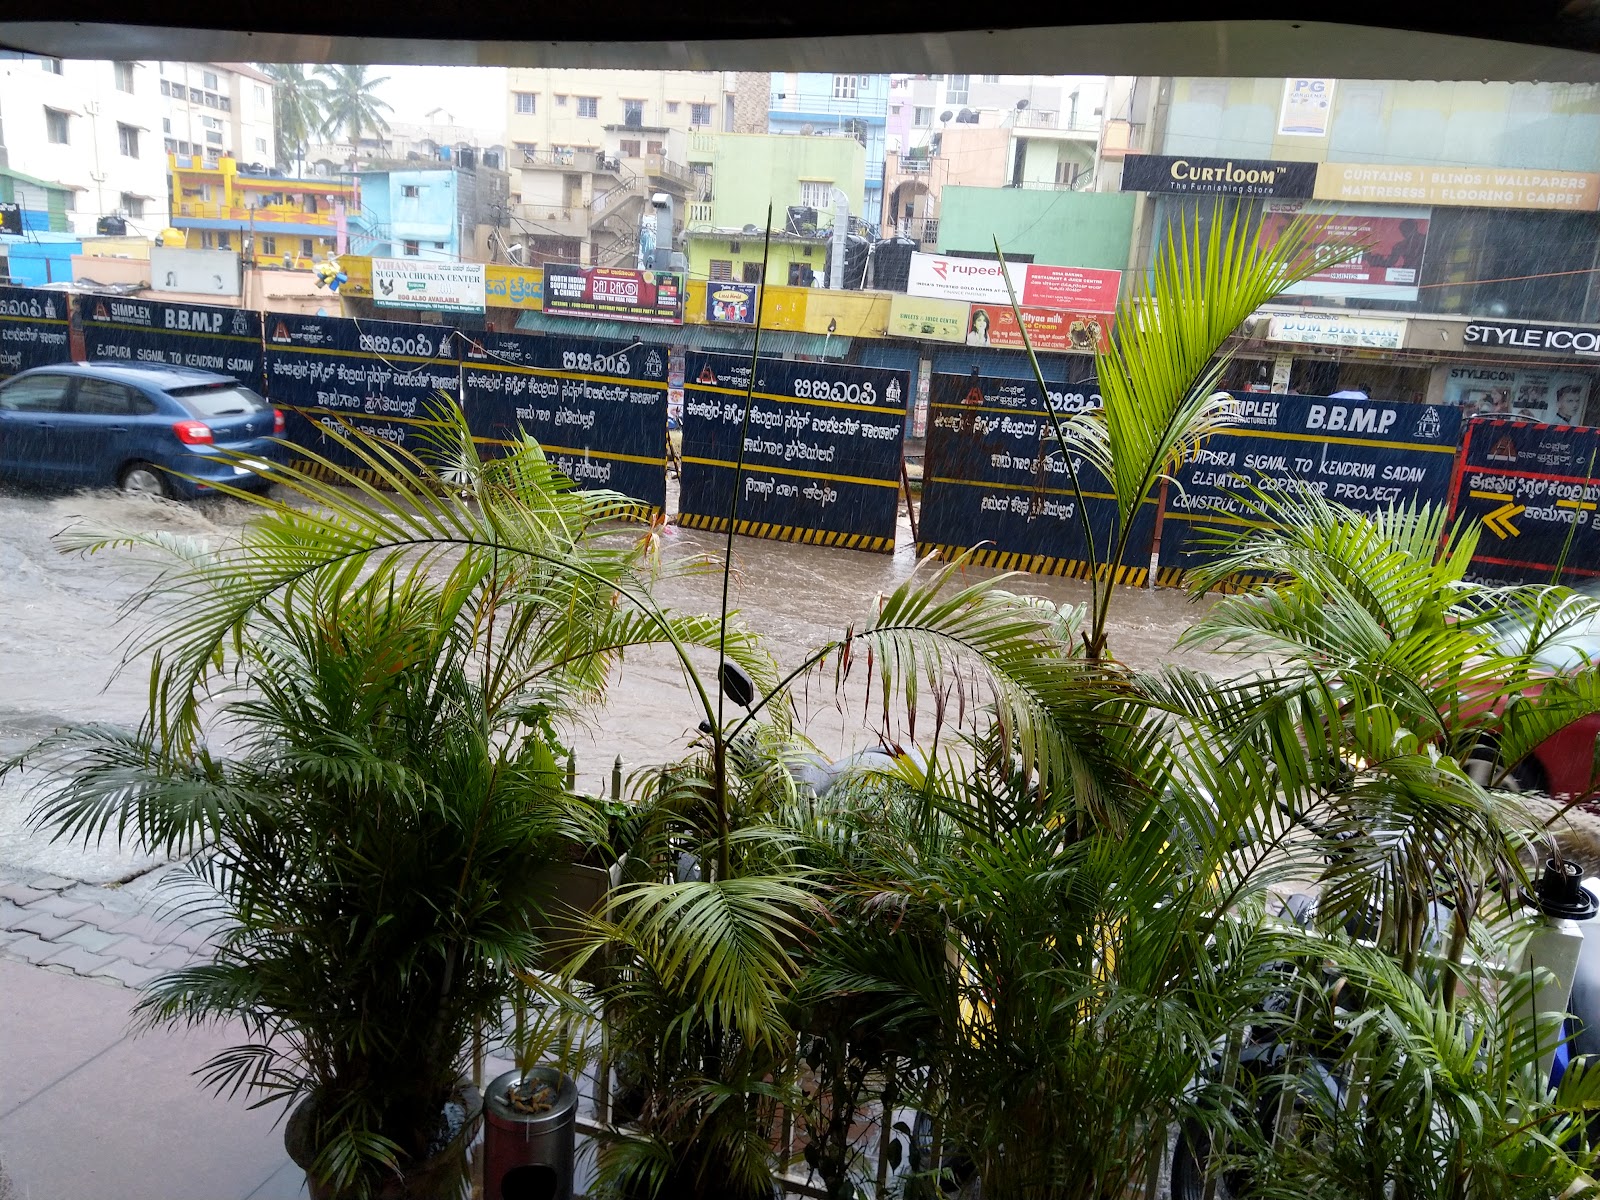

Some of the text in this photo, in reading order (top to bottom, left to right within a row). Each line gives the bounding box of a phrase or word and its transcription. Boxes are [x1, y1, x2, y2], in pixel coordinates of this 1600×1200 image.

[1295, 80, 1325, 92] PG
[1343, 169, 1587, 189] CURTAINS BLINDS WALLPAPERS
[1170, 182, 1275, 195] The Furnishing Store
[1341, 184, 1582, 205] MATTRESESS FLOORING CARPET
[375, 271, 480, 283] SUGUNA CHICKEN CENTER
[550, 275, 567, 283] NORTH
[559, 289, 581, 297] CHINESE
[593, 280, 607, 292] RAJ
[428, 296, 460, 304] AVAILABLE
[111, 303, 151, 320] SIMPLEX
[1020, 313, 1045, 324] dityaa
[1047, 313, 1063, 323] milk
[1464, 325, 1543, 347] STYLE
[96, 344, 254, 373] EJIPURA SIGNAL TO KENDRIYA SADAN
[1451, 368, 1515, 382] STYLEICON
[1221, 400, 1280, 418] SIMPLEX
[1183, 451, 1427, 483] EJIPURA SIGNAL TO KENDRIYA SADAN
[1191, 471, 1252, 489] ELEVATED
[1334, 483, 1402, 502] PROJECT
